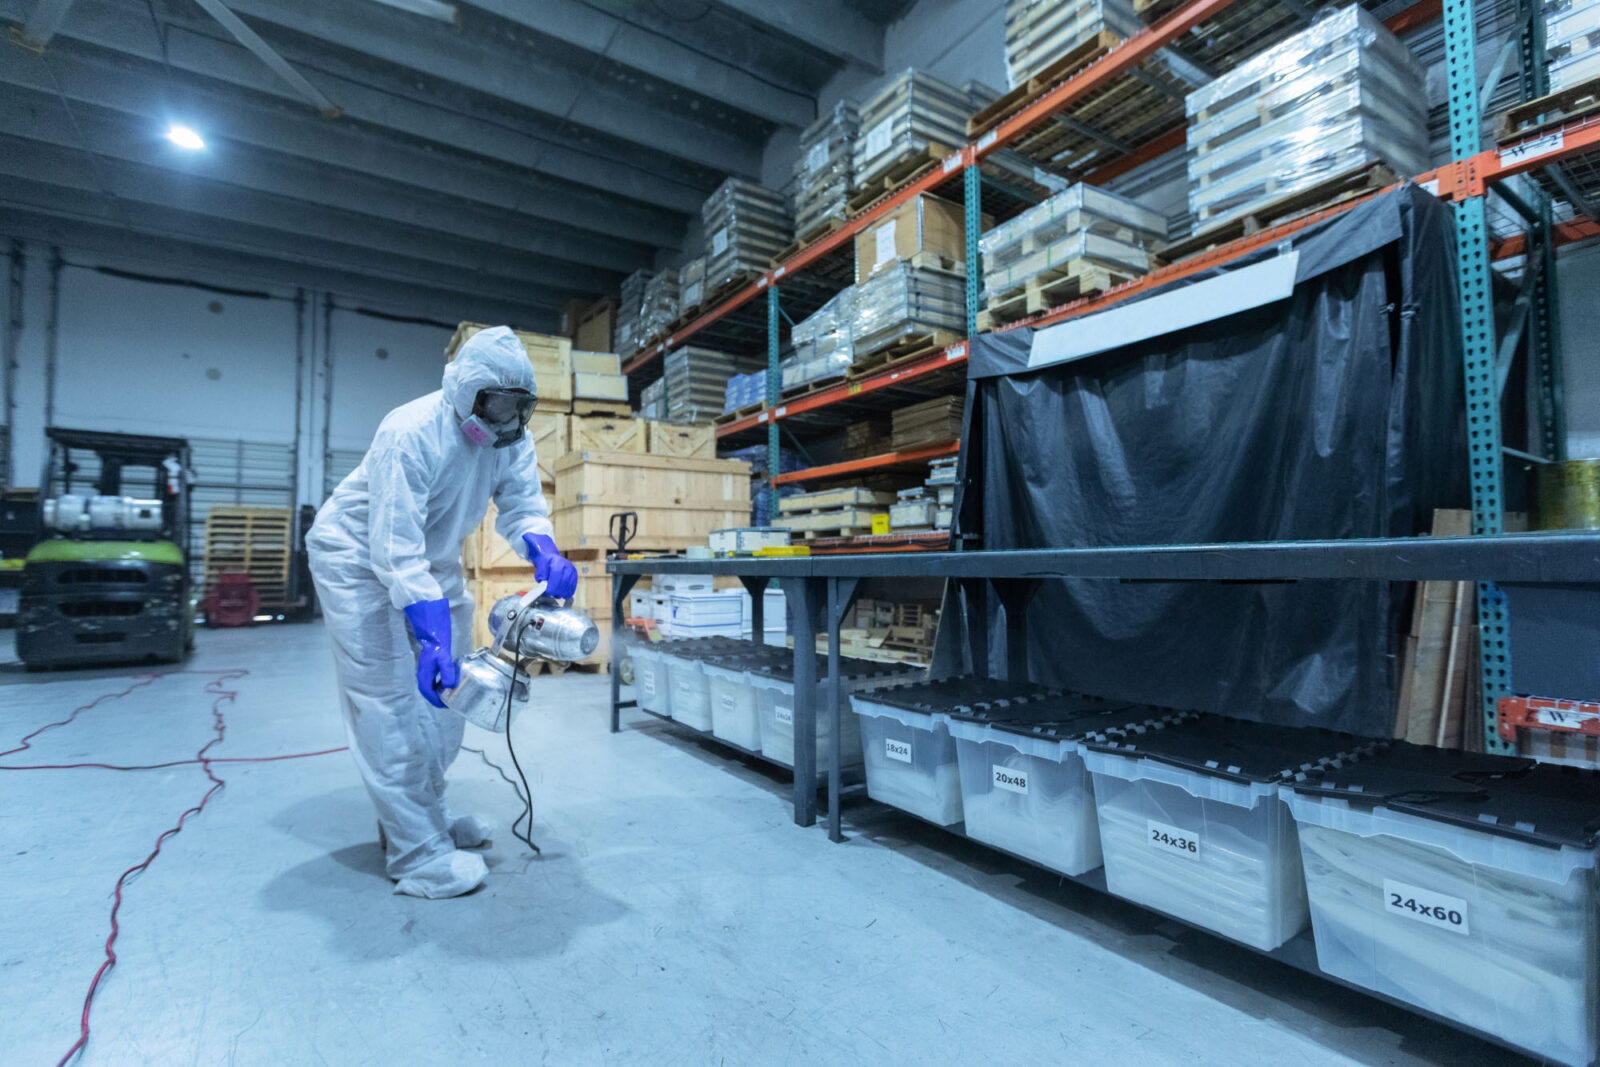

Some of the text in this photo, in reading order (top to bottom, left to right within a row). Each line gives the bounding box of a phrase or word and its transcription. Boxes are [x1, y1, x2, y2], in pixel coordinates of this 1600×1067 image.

[886, 743, 909, 756] 18x24
[995, 771, 1027, 788] 20x48
[1152, 829, 1197, 853] 24x36
[1391, 893, 1463, 925] 24x60
